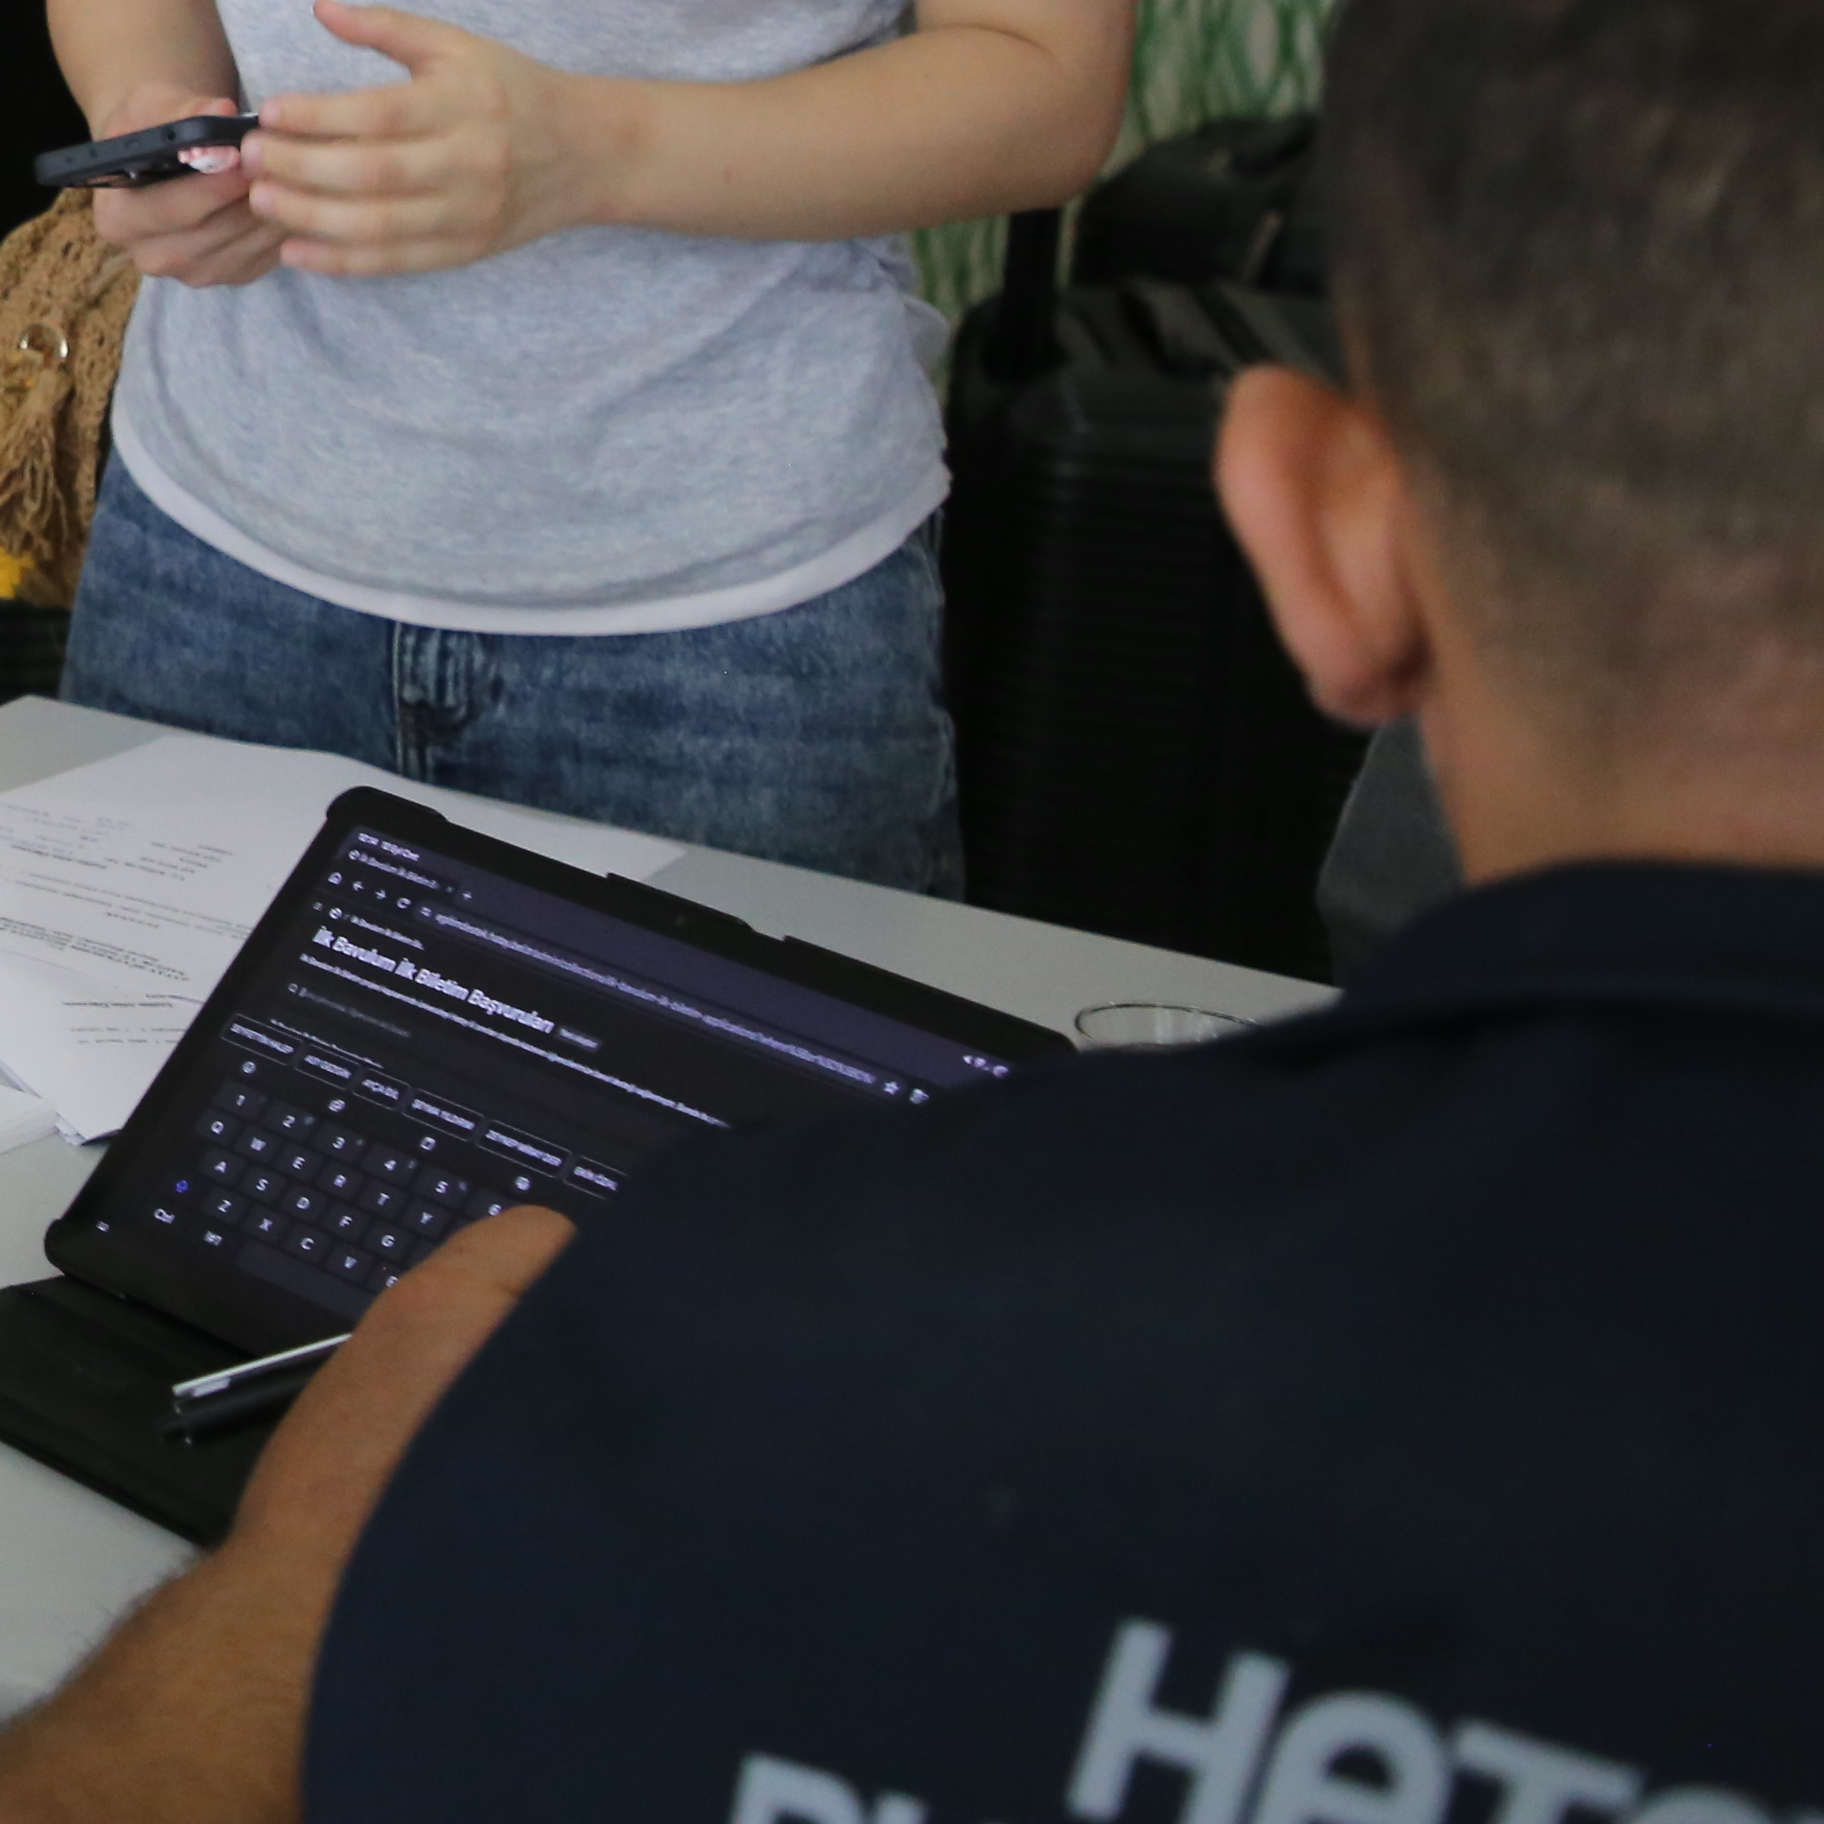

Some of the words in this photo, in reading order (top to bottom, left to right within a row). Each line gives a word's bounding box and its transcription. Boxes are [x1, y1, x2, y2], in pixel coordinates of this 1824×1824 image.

[332, 936, 397, 973] Bavulum
[211, 1121, 224, 1134] Q
[292, 1156, 305, 1170] E
[333, 1174, 346, 1187] R
[378, 1192, 390, 1205] T
[421, 1211, 433, 1224] Y
[236, 1094, 246, 1106] 1
[282, 1115, 296, 1128] 2
[332, 1136, 345, 1149] 3
[384, 1159, 397, 1171] 4
[435, 1180, 449, 1194] 5
[488, 1203, 502, 1217] 6
[215, 1161, 228, 1173] A
[256, 1178, 269, 1192] S
[296, 1196, 310, 1209] D
[340, 1215, 353, 1227] F
[381, 1234, 395, 1247] G
[218, 1199, 231, 1213] Z
[259, 1218, 272, 1231] X
[301, 1237, 314, 1250] C
